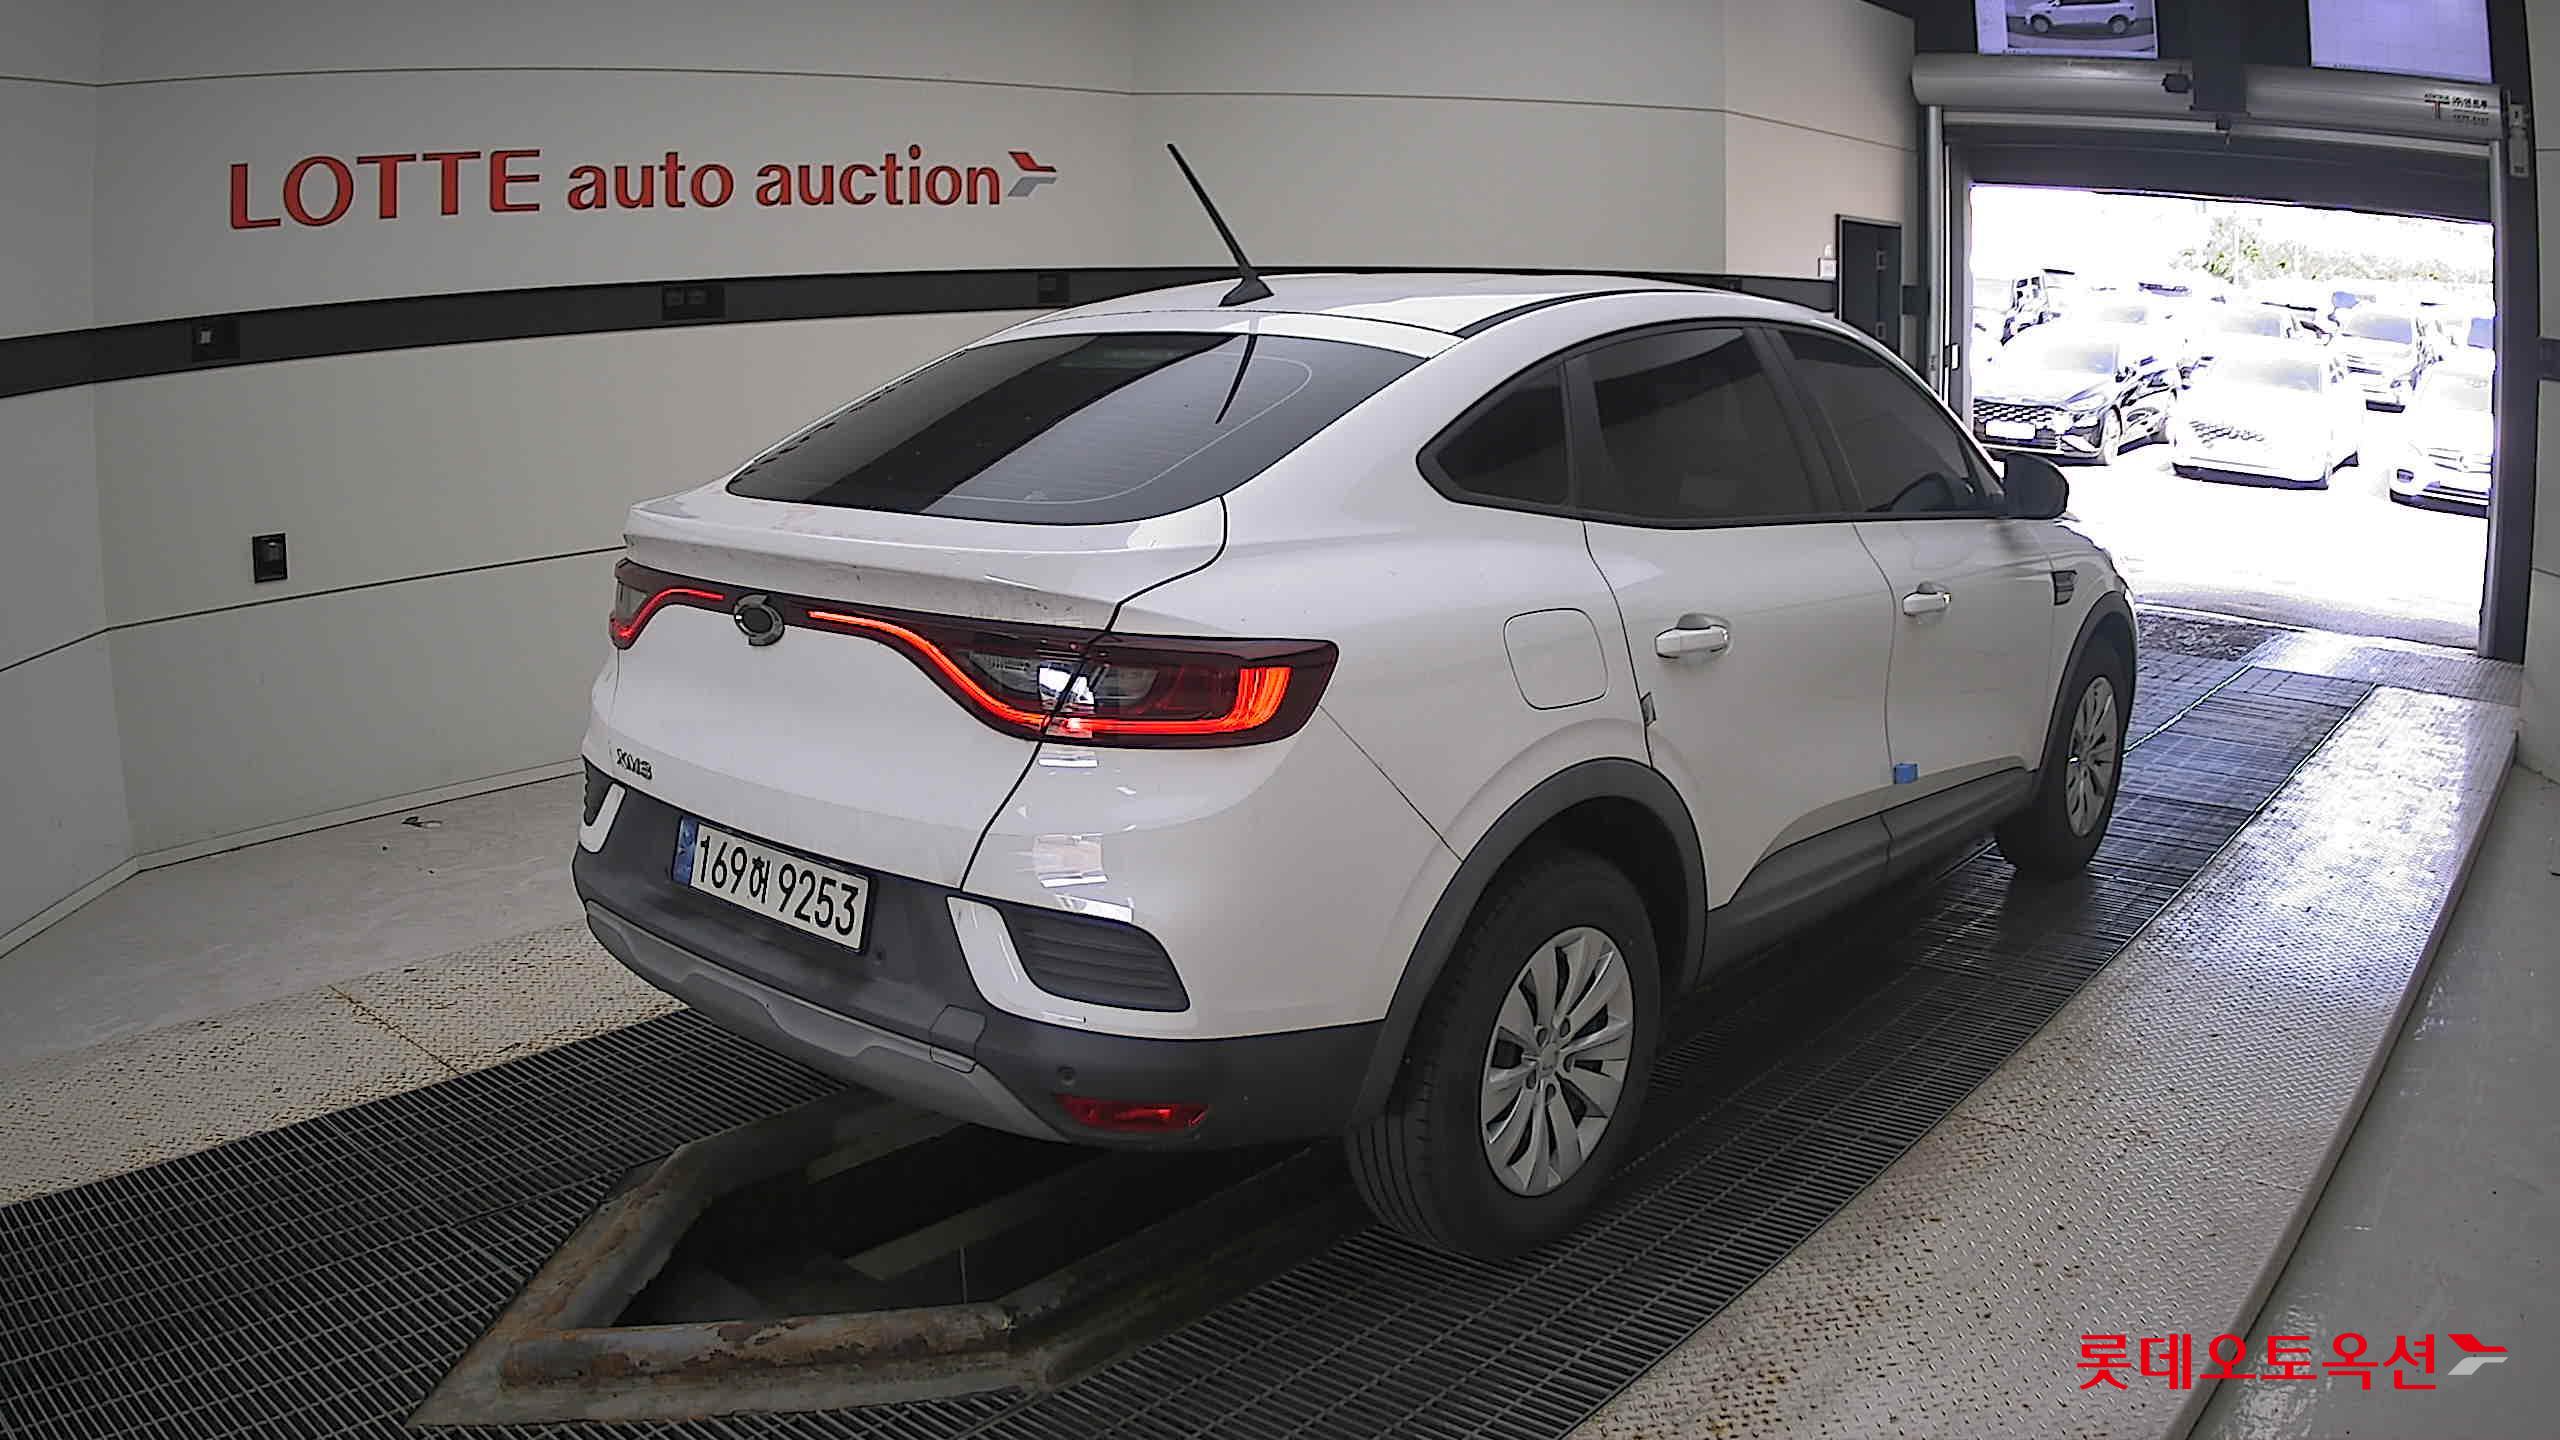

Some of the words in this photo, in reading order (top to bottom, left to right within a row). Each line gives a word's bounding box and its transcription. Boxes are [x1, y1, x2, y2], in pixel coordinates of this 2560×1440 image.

[230, 149, 541, 231] LOTTE
[567, 151, 735, 210] auto
[755, 144, 1002, 207] auction
[616, 748, 653, 780] XM3
[699, 835, 771, 904] 169허
[777, 863, 860, 936] 9253
